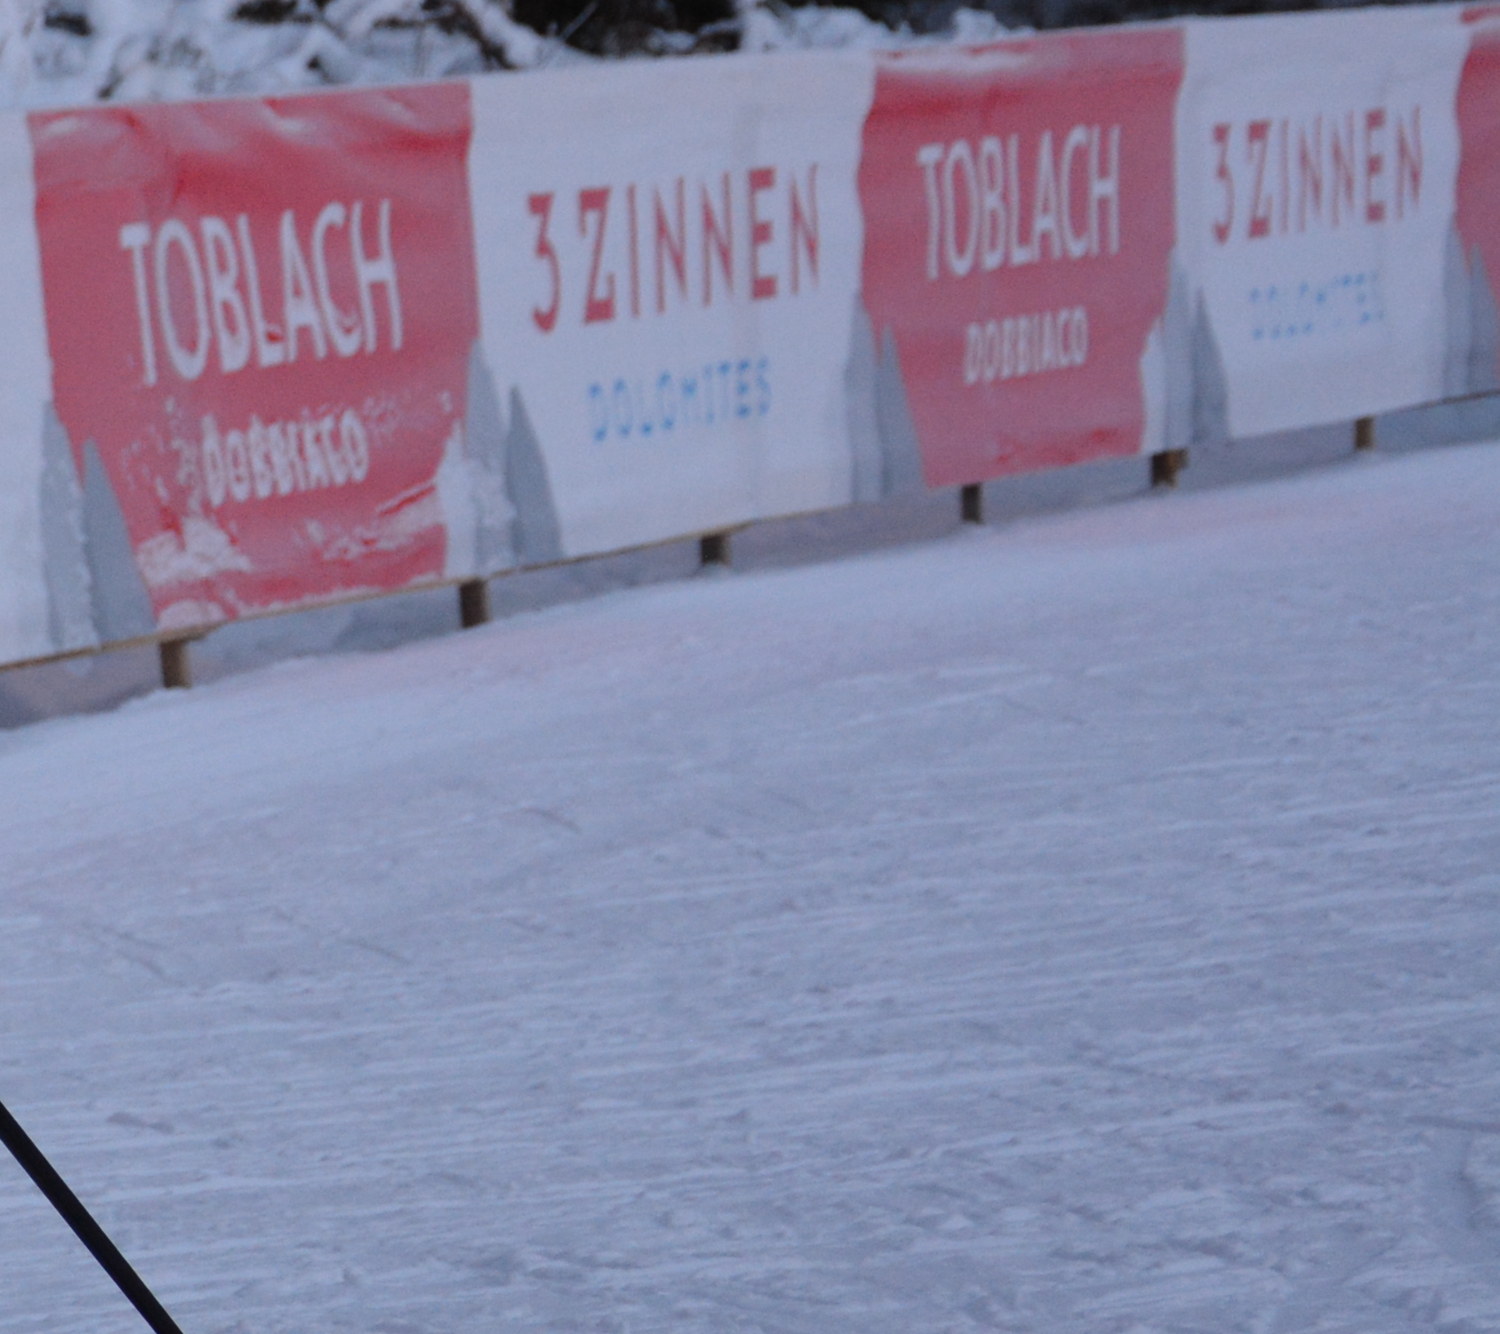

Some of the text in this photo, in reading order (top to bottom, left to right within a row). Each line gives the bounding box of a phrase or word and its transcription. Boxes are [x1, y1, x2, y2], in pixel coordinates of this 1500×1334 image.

[578, 161, 820, 328] ZINNEN
[916, 122, 1122, 282] TOBLACH
[1246, 104, 1424, 240] ZINNEN
[119, 198, 404, 388] TOBLACH
